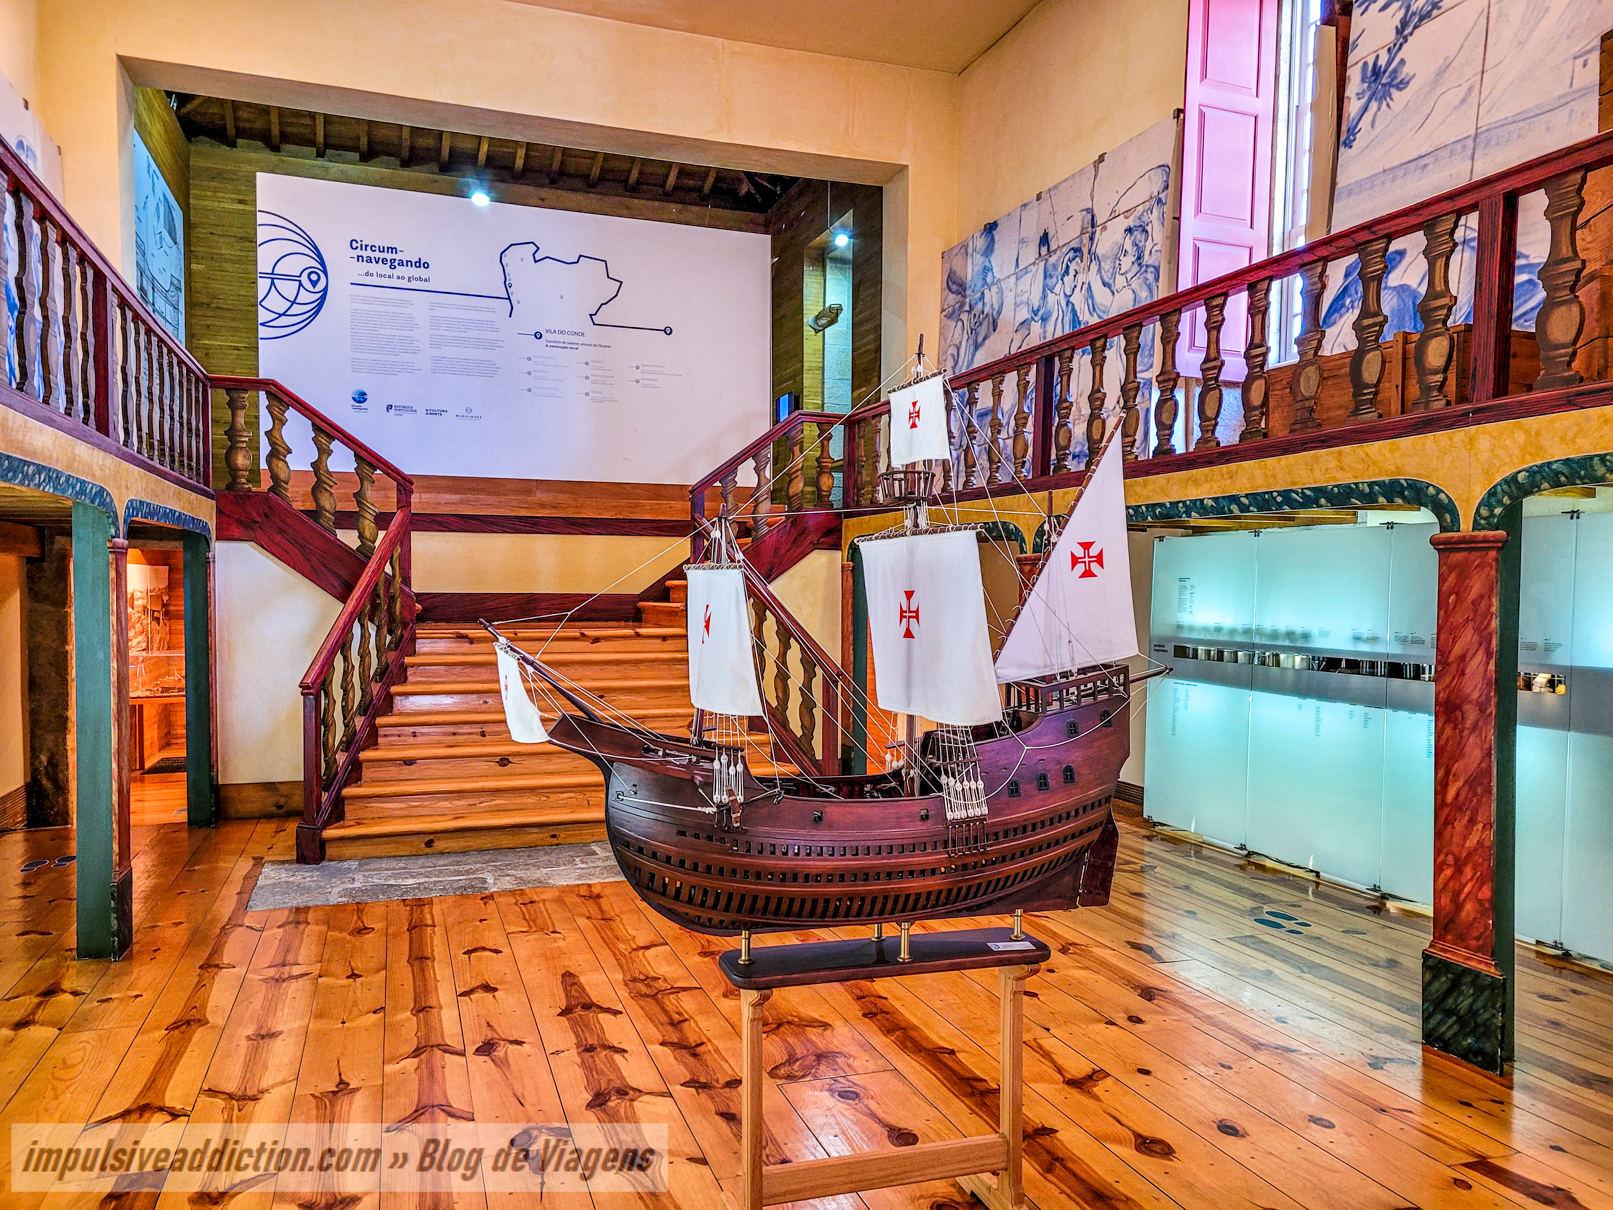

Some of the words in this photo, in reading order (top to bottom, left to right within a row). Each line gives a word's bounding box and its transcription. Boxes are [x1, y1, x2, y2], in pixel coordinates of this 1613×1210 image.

[349, 239, 404, 254] Circum-
[350, 254, 430, 270] -navegando
[376, 271, 394, 280] local
[407, 274, 431, 283] global
